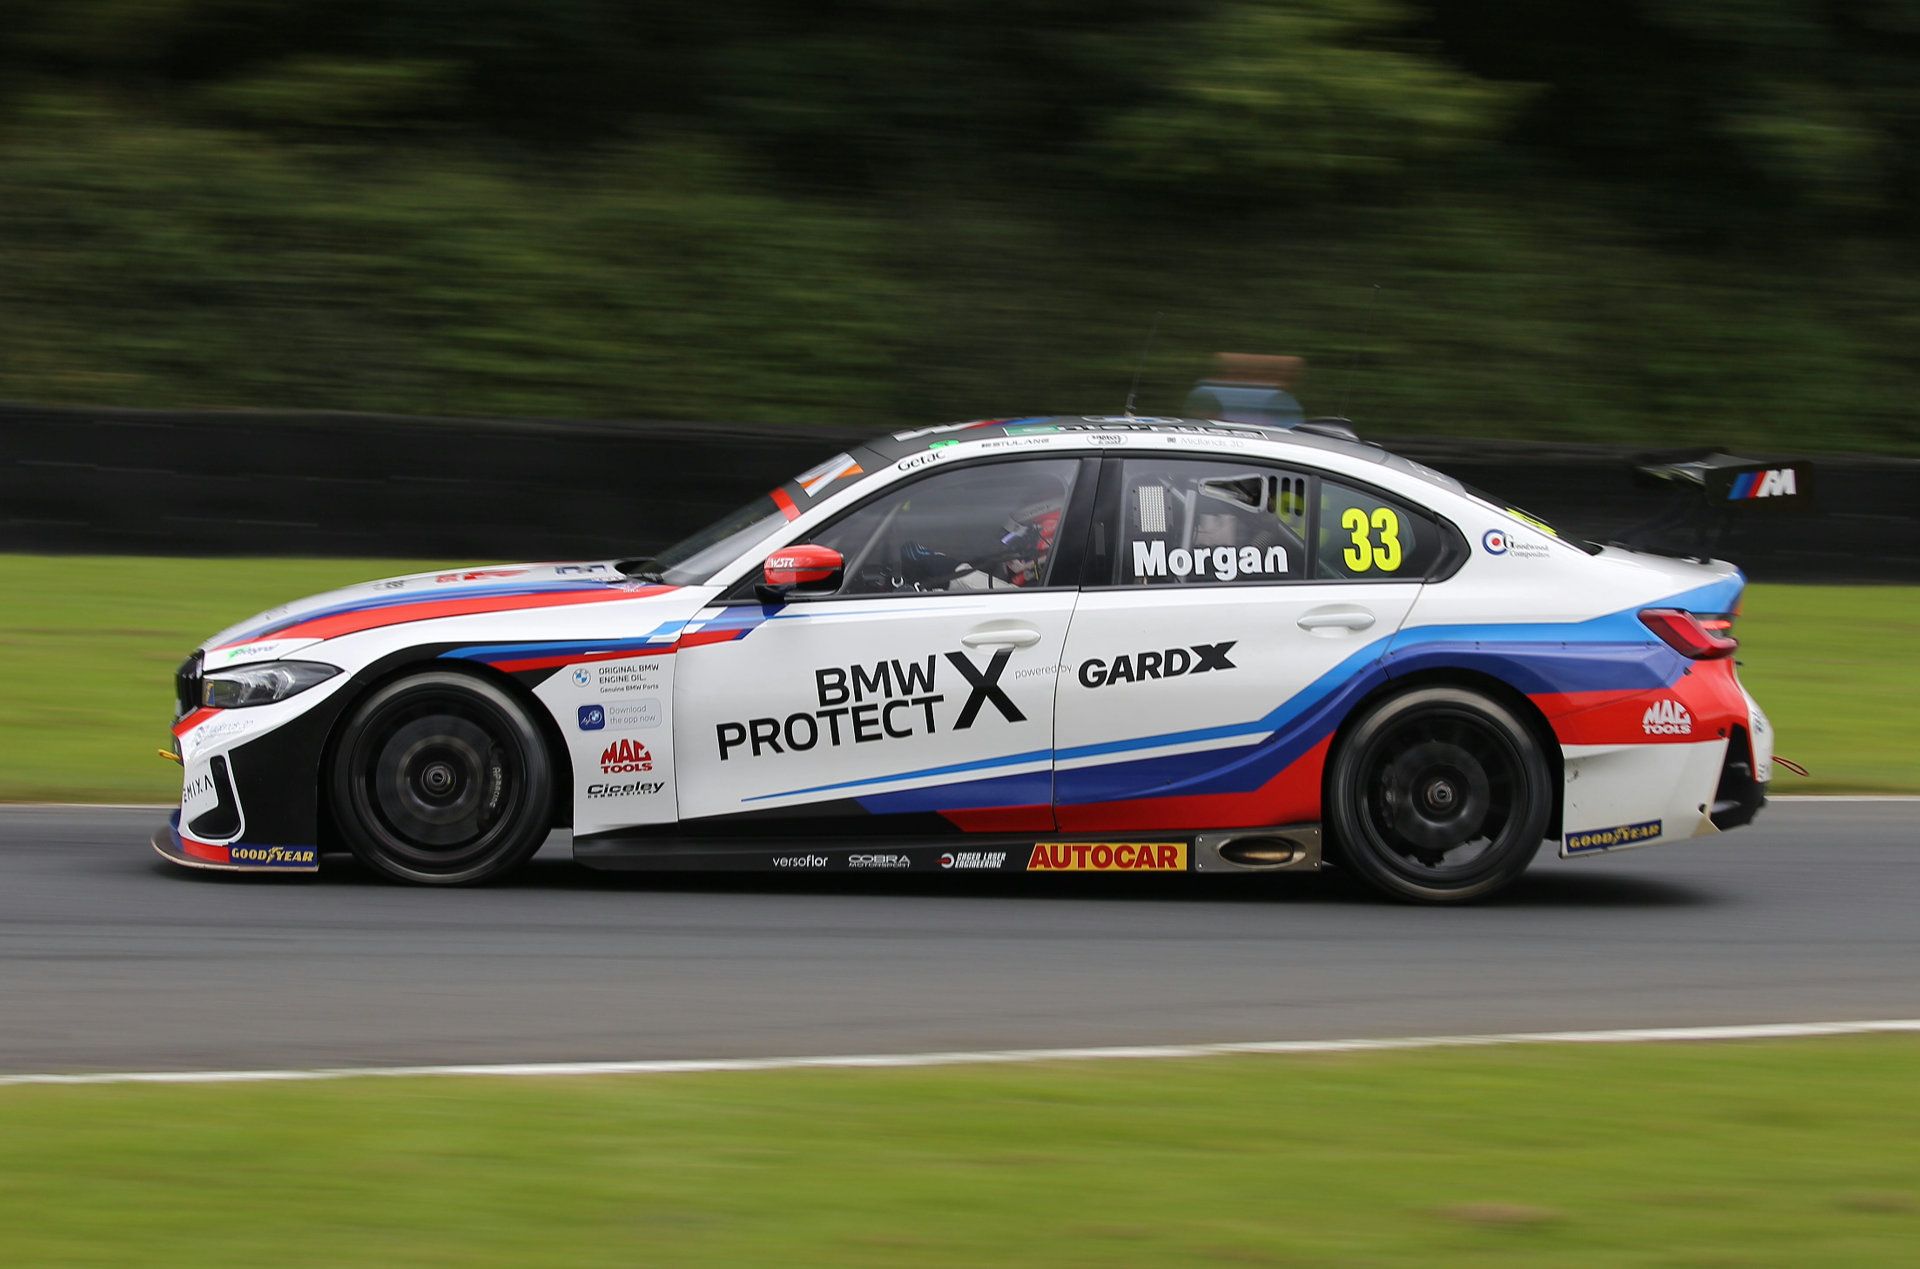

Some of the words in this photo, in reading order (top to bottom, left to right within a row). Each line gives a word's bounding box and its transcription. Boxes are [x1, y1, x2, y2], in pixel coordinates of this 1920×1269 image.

[897, 451, 947, 472] Getac
[1341, 507, 1403, 573] 33
[1132, 540, 1289, 582] Morgan
[598, 665, 637, 675] ORIGINAL
[638, 663, 659, 673] BMW
[1014, 663, 1057, 680] powered
[1059, 663, 1073, 675] by
[1078, 640, 1239, 689] GARDX
[599, 674, 629, 685] ENGINE
[815, 654, 937, 707] BMW
[600, 686, 624, 694] Genuine
[625, 684, 642, 693] BMW
[642, 683, 659, 691] Parts
[609, 704, 647, 715] Download
[715, 694, 944, 761] PROTECT
[944, 646, 1028, 732] X
[1642, 699, 1692, 725] MAC
[609, 715, 622, 725] the
[623, 715, 638, 725] app
[639, 715, 656, 723] now
[1642, 724, 1692, 735] TOOLS
[600, 738, 652, 765] MAC
[600, 762, 653, 775] TOOLS
[587, 781, 666, 795] Ciceley
[231, 846, 314, 864] GOODYEAR
[772, 854, 829, 867] versoflor
[848, 854, 911, 864] COBRA
[1028, 844, 1179, 870] AUTOCAR
[954, 860, 1003, 869] ENGINEERING
